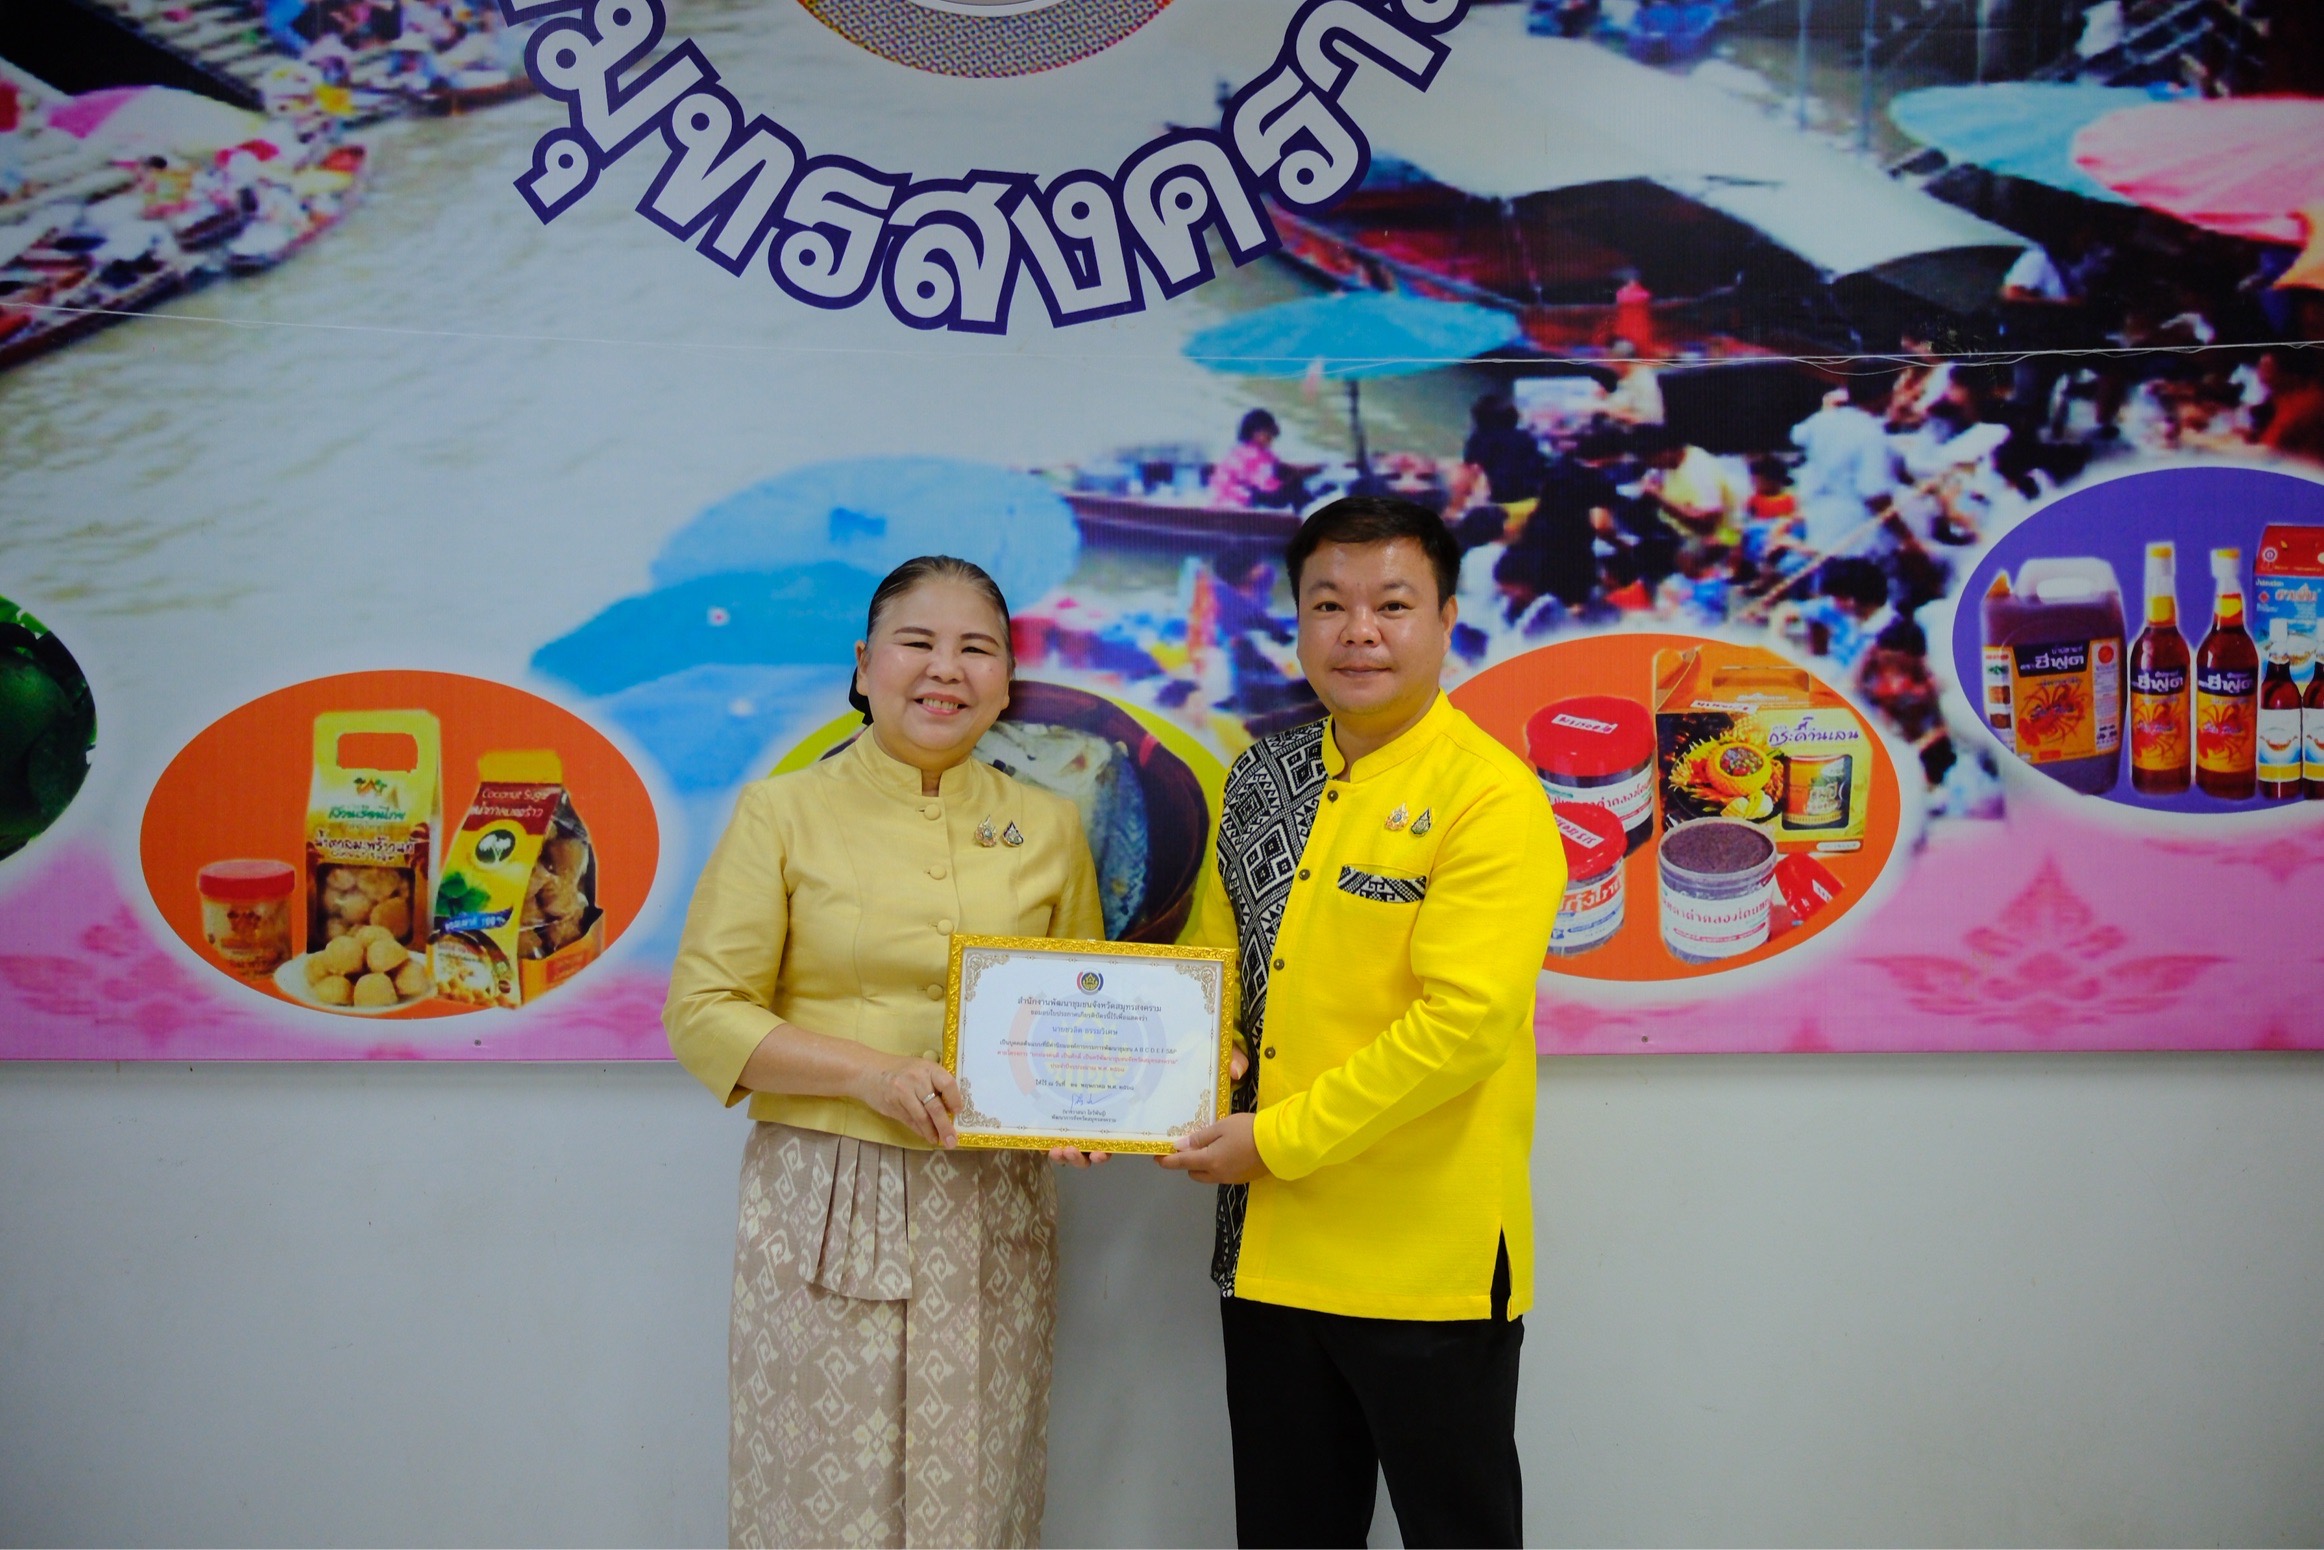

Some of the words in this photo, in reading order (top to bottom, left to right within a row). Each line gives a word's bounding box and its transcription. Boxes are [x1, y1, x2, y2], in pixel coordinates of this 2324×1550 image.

[497, 0, 1471, 335] มุทรสงครา
[1017, 996, 1162, 1013] สำนักงานพัฒนาชุมชนจังหวัดสมุทรสงคราม
